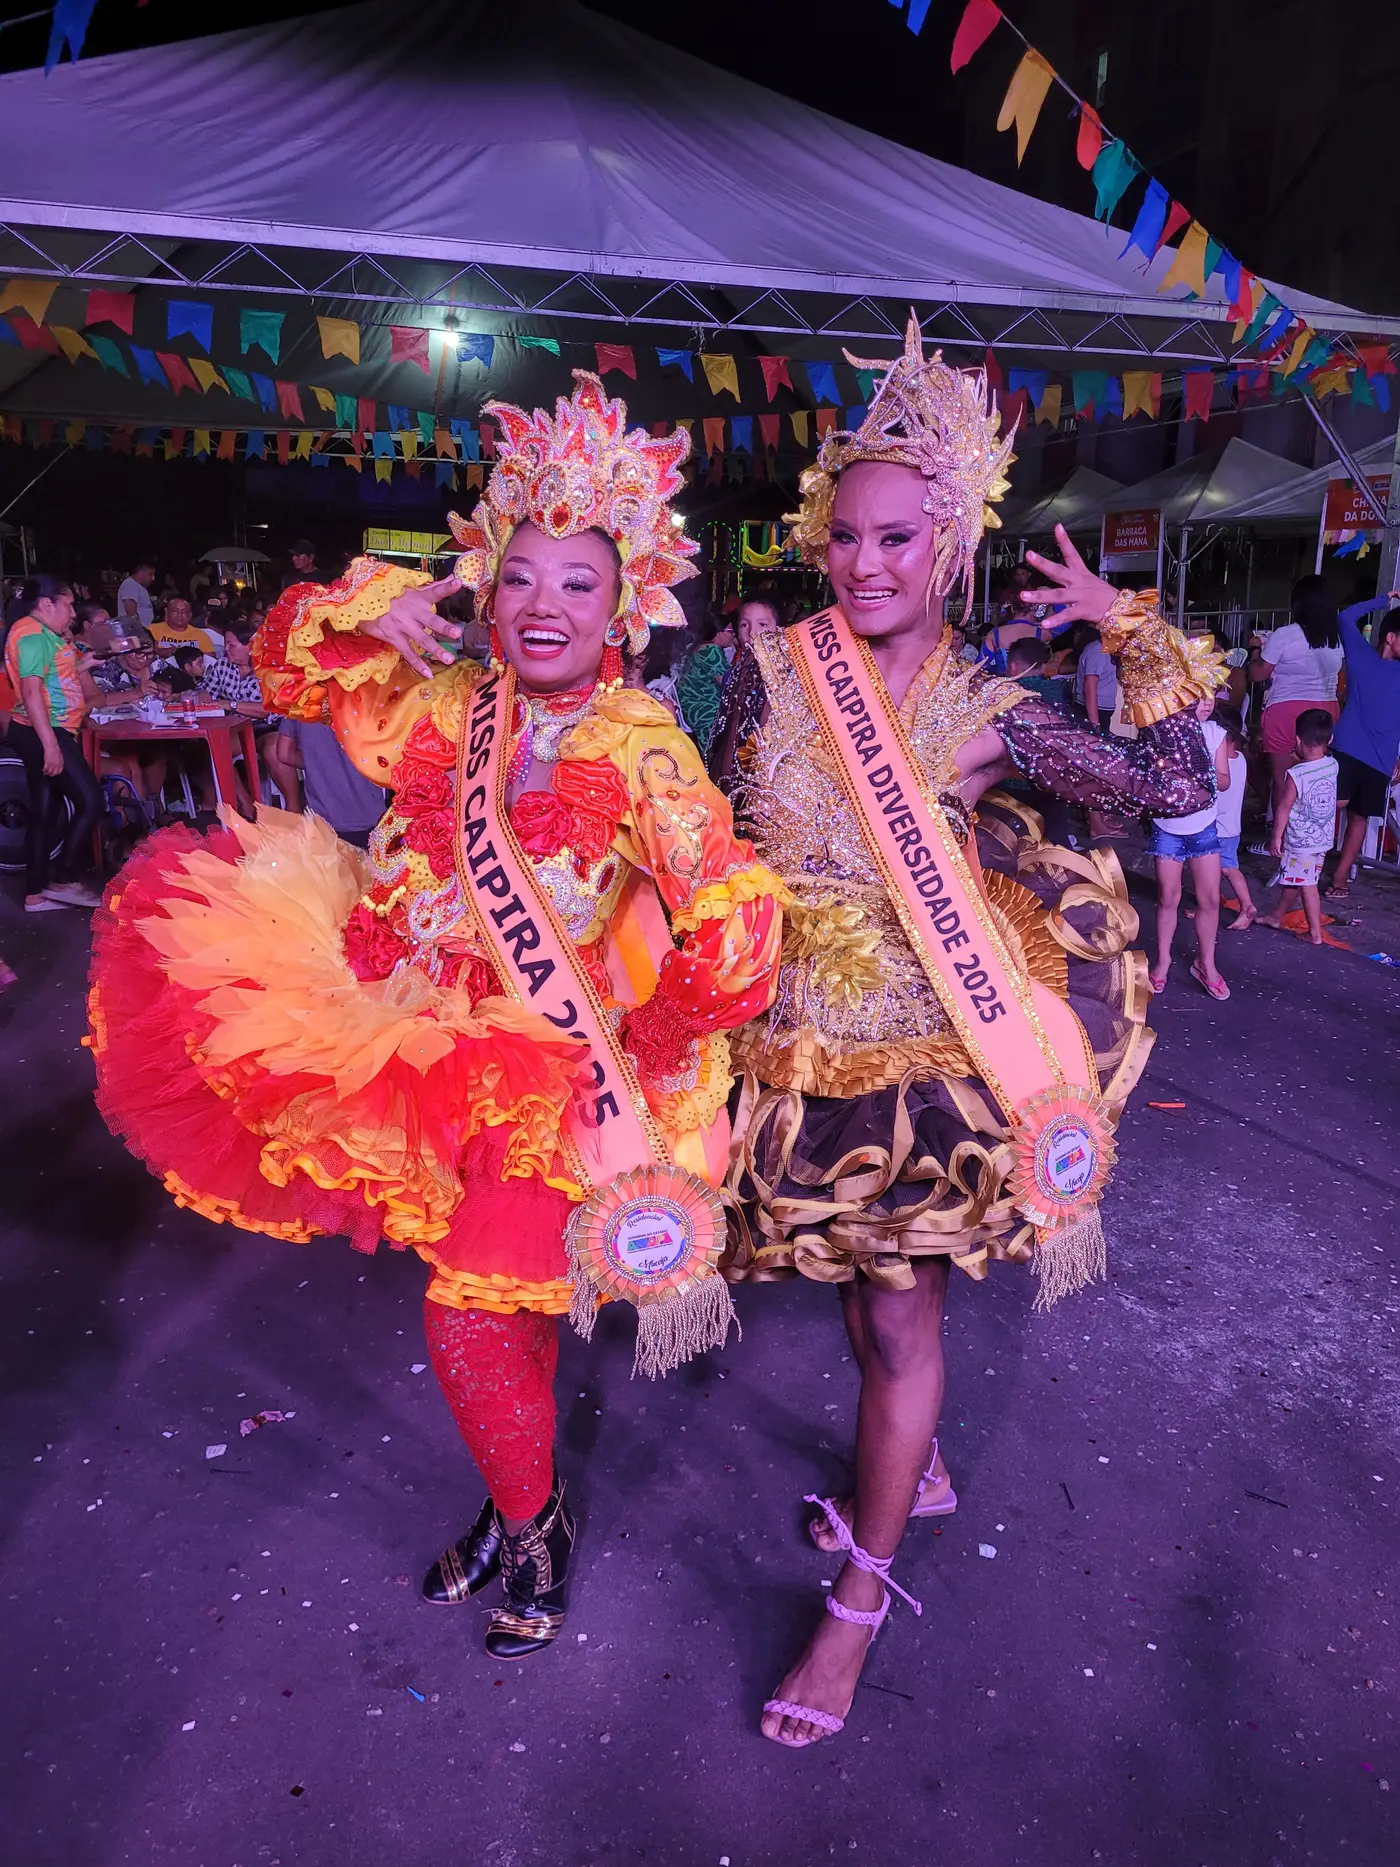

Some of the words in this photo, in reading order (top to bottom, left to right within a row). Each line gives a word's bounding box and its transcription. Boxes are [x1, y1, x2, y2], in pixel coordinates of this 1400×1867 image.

[1114, 538, 1128, 547] DAS
[1116, 526, 1147, 537] BARRACA
[1344, 511, 1358, 522] DA
[466, 675, 500, 780] MISS
[807, 612, 842, 662] MISS
[825, 659, 882, 766] CAIPIRA
[866, 763, 970, 954] DIVERSIDADE
[953, 953, 1006, 1024] 2025
[463, 784, 556, 998] CAIPIRA
[542, 999, 620, 1129] 225
[627, 1214, 663, 1229] Residencial
